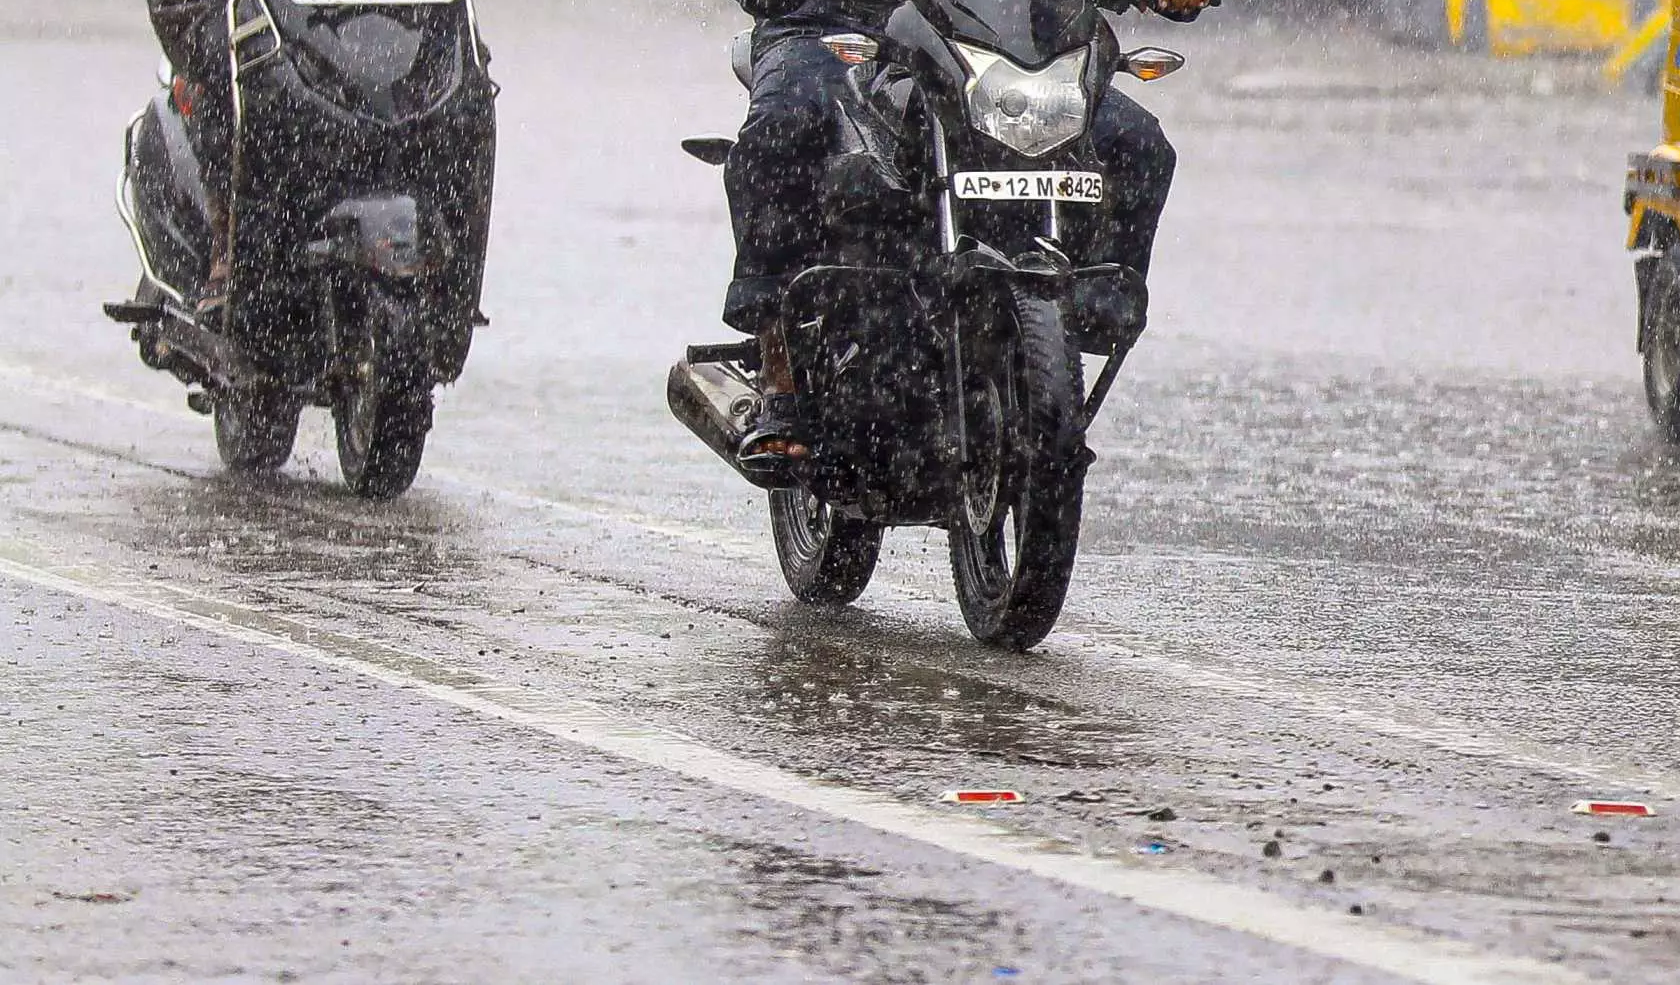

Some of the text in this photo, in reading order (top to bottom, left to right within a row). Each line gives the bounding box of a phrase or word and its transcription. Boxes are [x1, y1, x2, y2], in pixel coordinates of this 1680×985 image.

[962, 176, 991, 195] AP
[1006, 177, 1030, 197] 12
[1036, 177, 1054, 197] M
